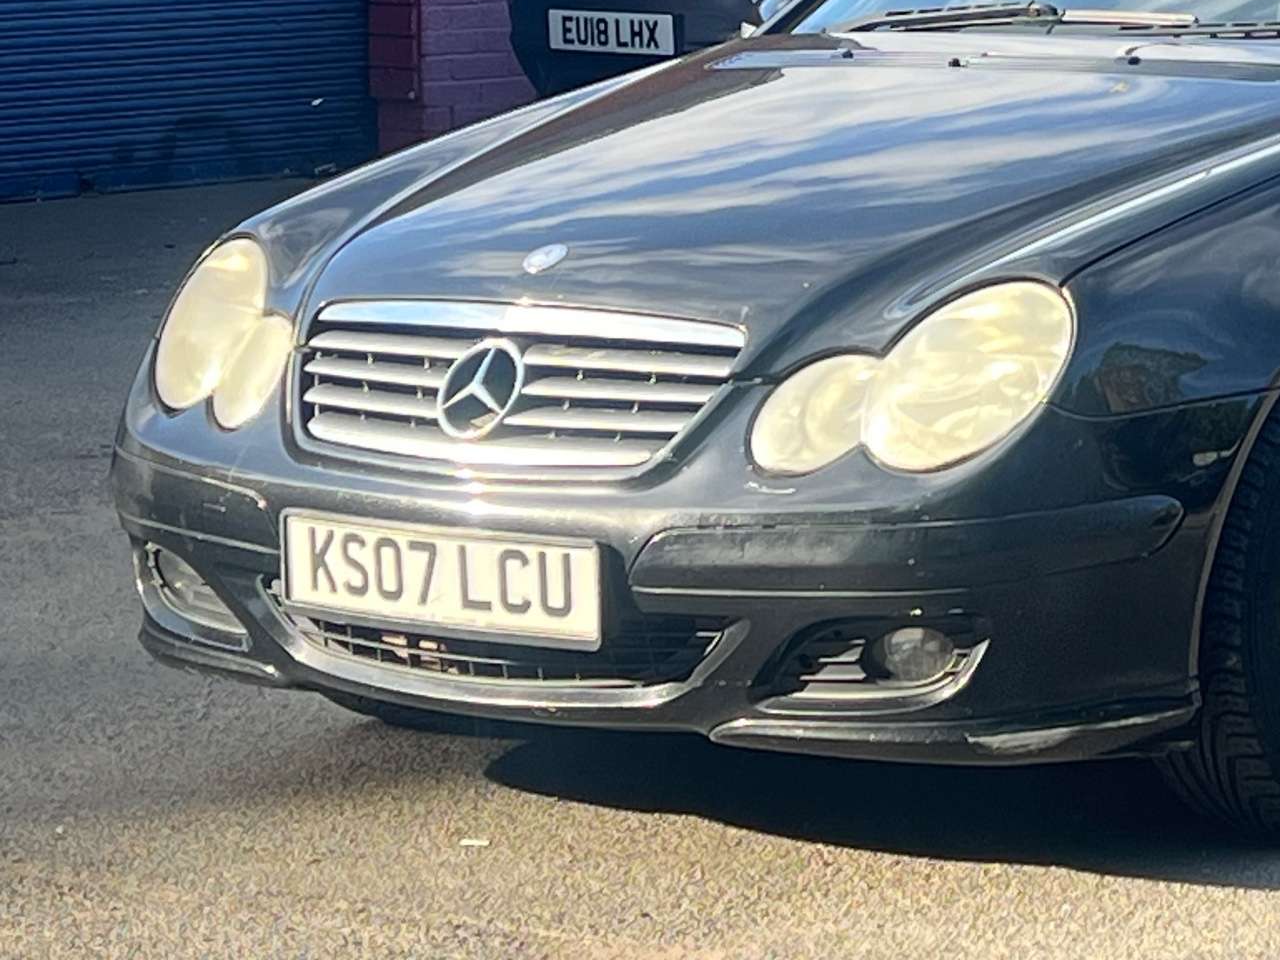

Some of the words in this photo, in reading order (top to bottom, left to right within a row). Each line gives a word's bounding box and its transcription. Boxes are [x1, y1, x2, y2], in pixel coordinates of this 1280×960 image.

[561, 16, 609, 47] EU18
[615, 18, 659, 49] LHX
[308, 526, 437, 605] KS07
[458, 544, 572, 618] LCU
